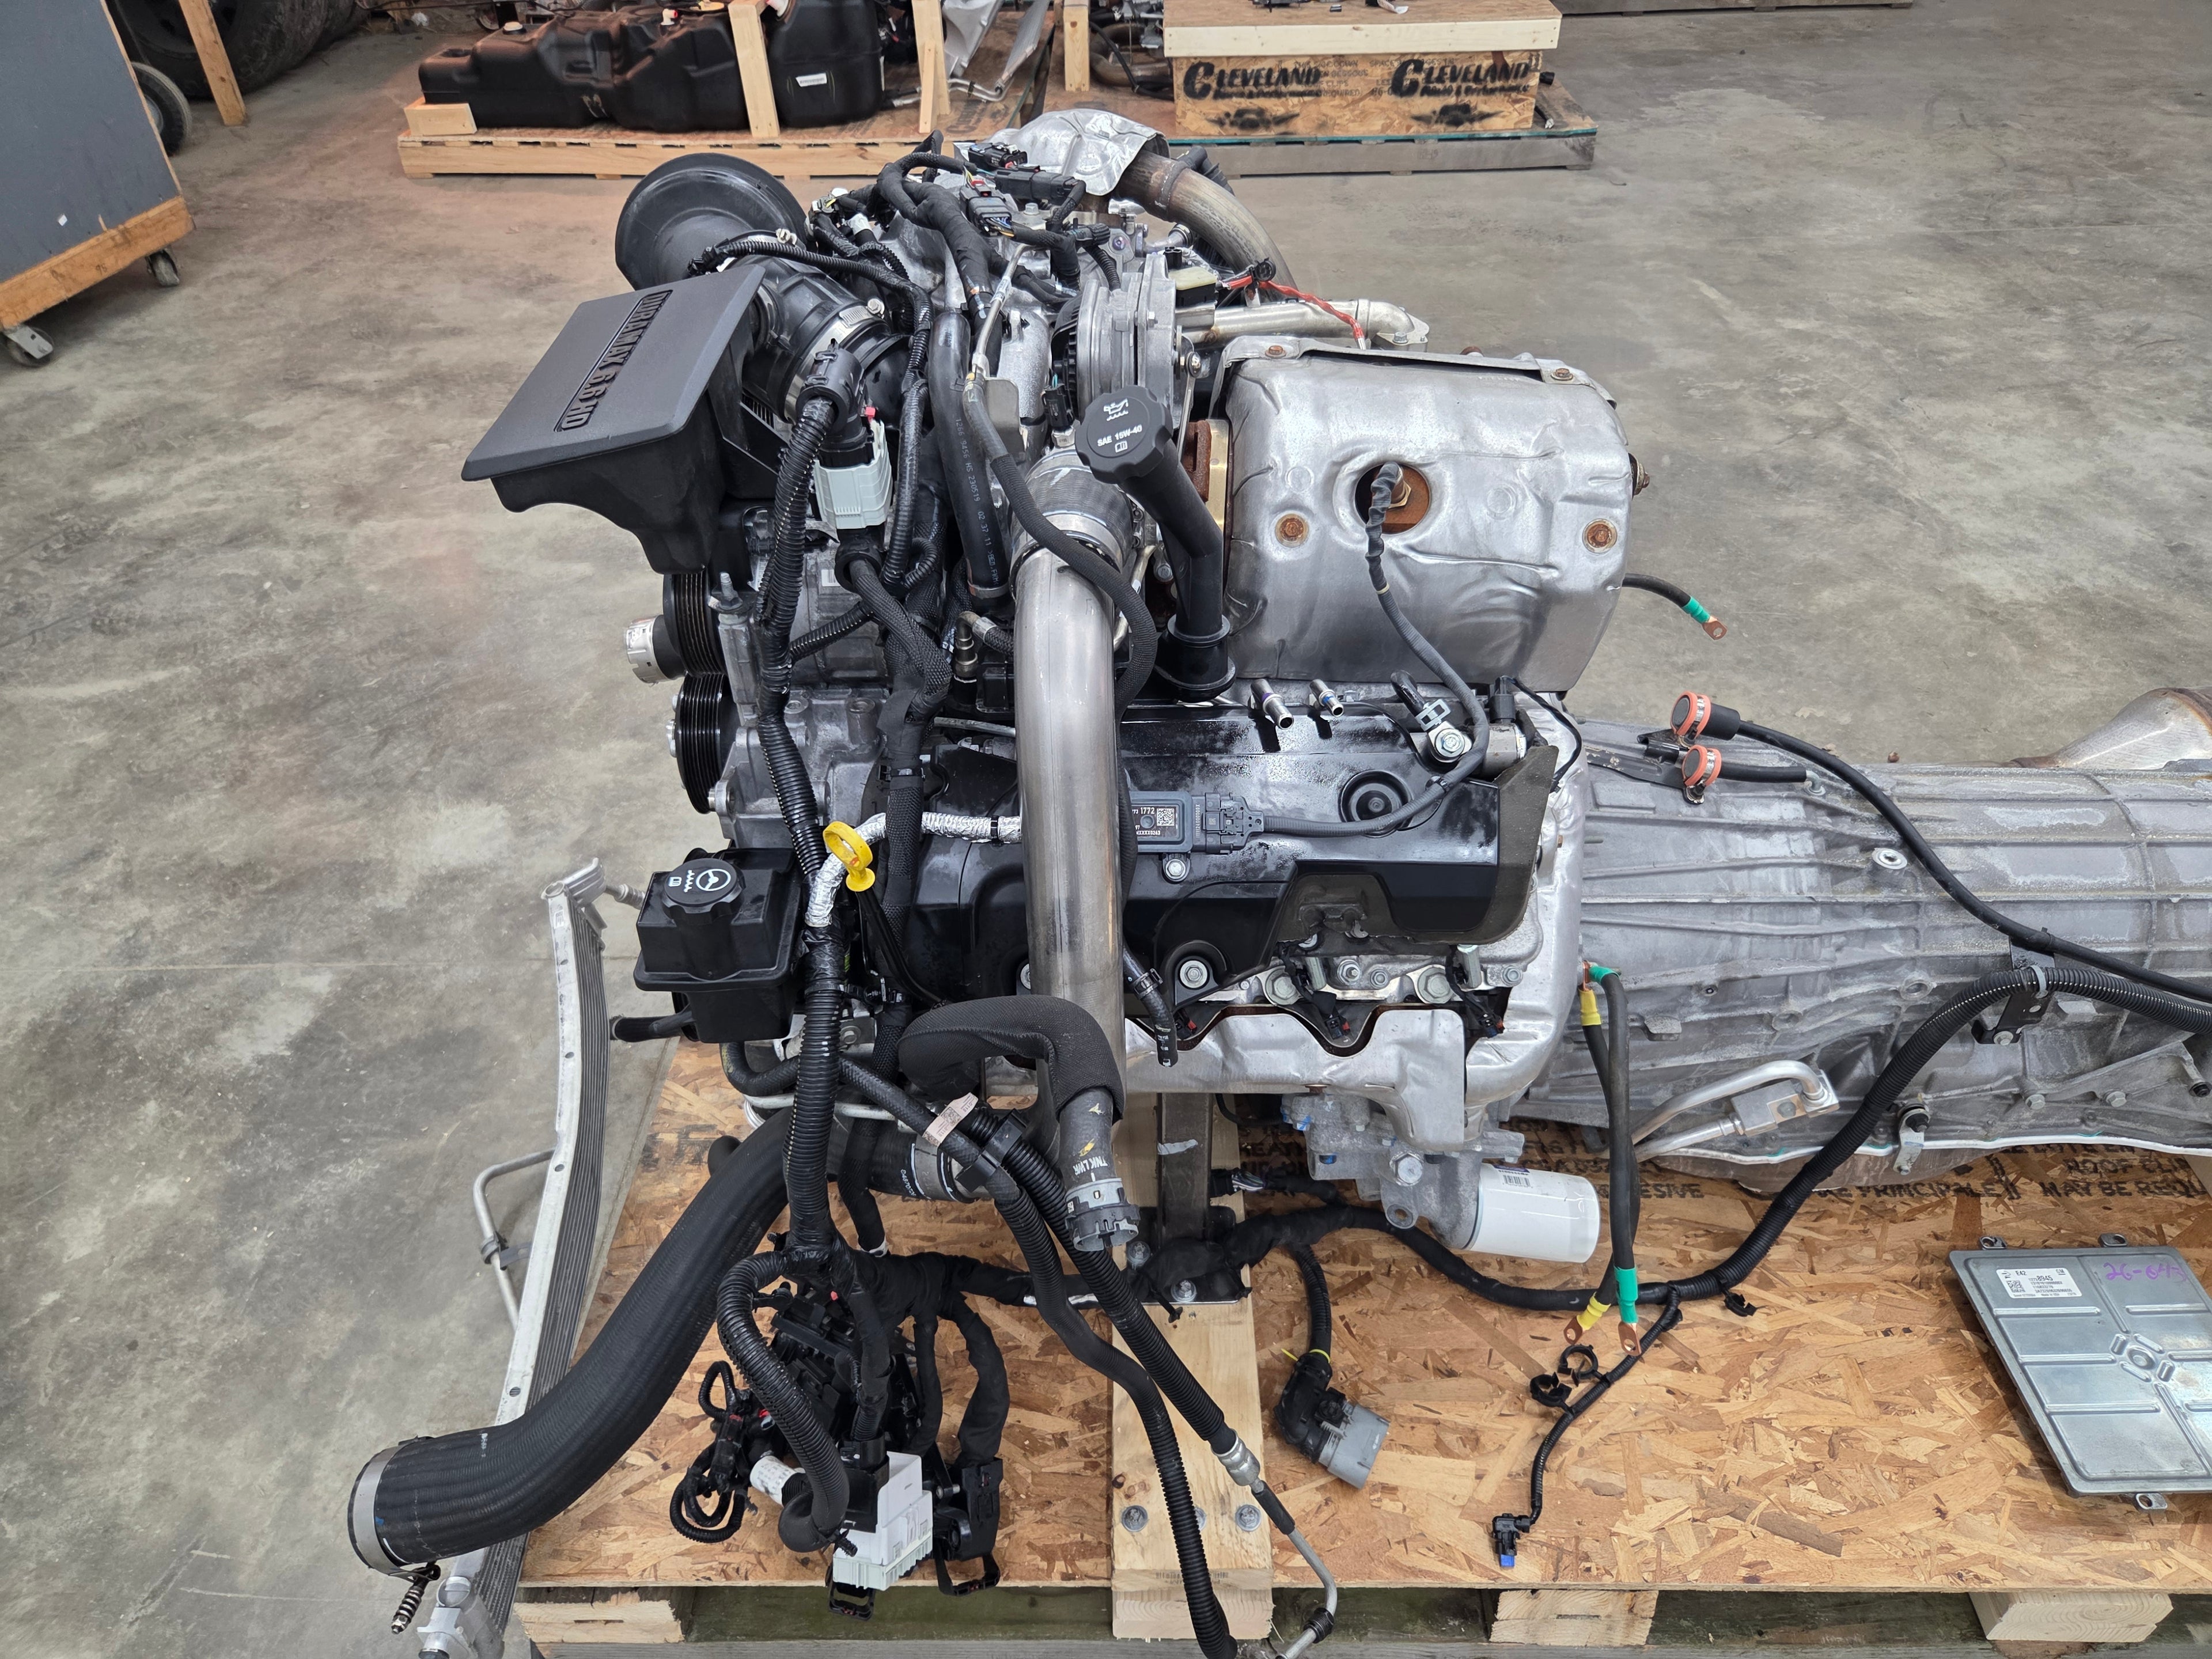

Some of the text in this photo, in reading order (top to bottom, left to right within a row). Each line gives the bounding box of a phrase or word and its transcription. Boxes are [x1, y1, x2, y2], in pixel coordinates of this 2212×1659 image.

[561, 291, 669, 431] DURAMAX 6.6 HD
[955, 418, 964, 437] 1266
[1097, 423, 1143, 447] SAE 15W-40
[965, 462, 974, 472] HS
[968, 475, 980, 502] 230519
[1089, 1156, 1108, 1169] TNK
[2039, 1181, 2093, 1198] MAY
[2100, 1182, 2134, 1197] BE
